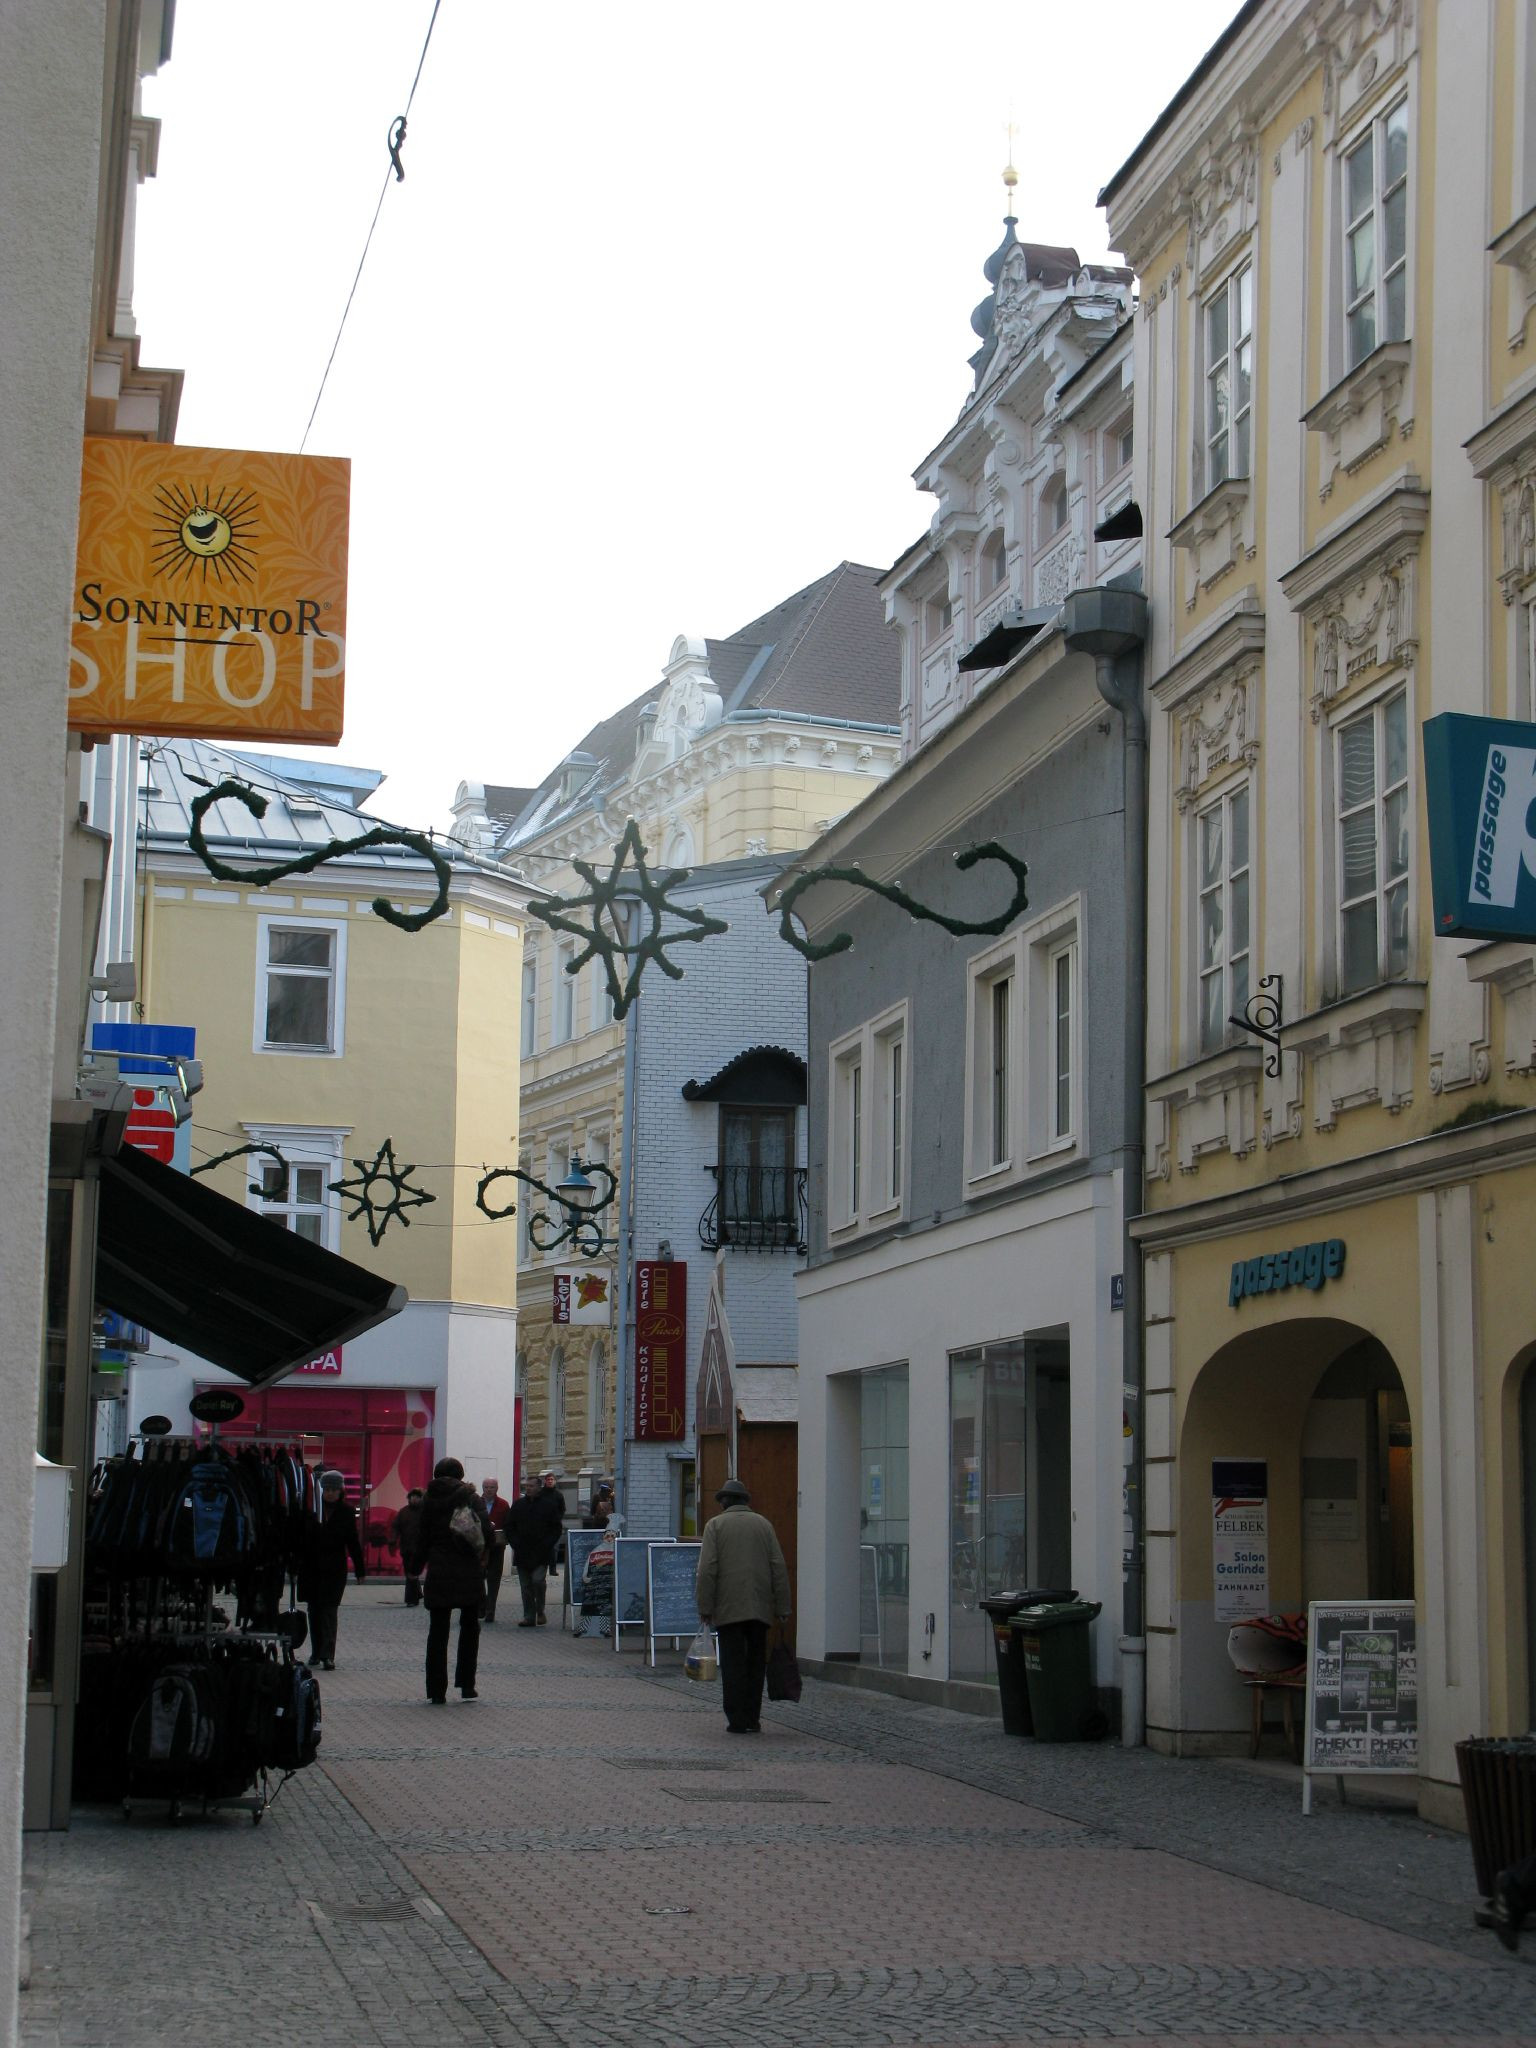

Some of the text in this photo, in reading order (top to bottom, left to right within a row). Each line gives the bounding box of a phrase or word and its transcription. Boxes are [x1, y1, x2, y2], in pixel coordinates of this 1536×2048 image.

[1473, 749, 1508, 902] passage
[1228, 1238, 1346, 1307] passage
[639, 1345, 650, 1436] Konditorei
[1216, 1520, 1264, 1532] FELBEK
[1234, 1551, 1265, 1562] Salon
[1216, 1563, 1265, 1574] Gerlinde
[1314, 1737, 1362, 1749] PHEKT
